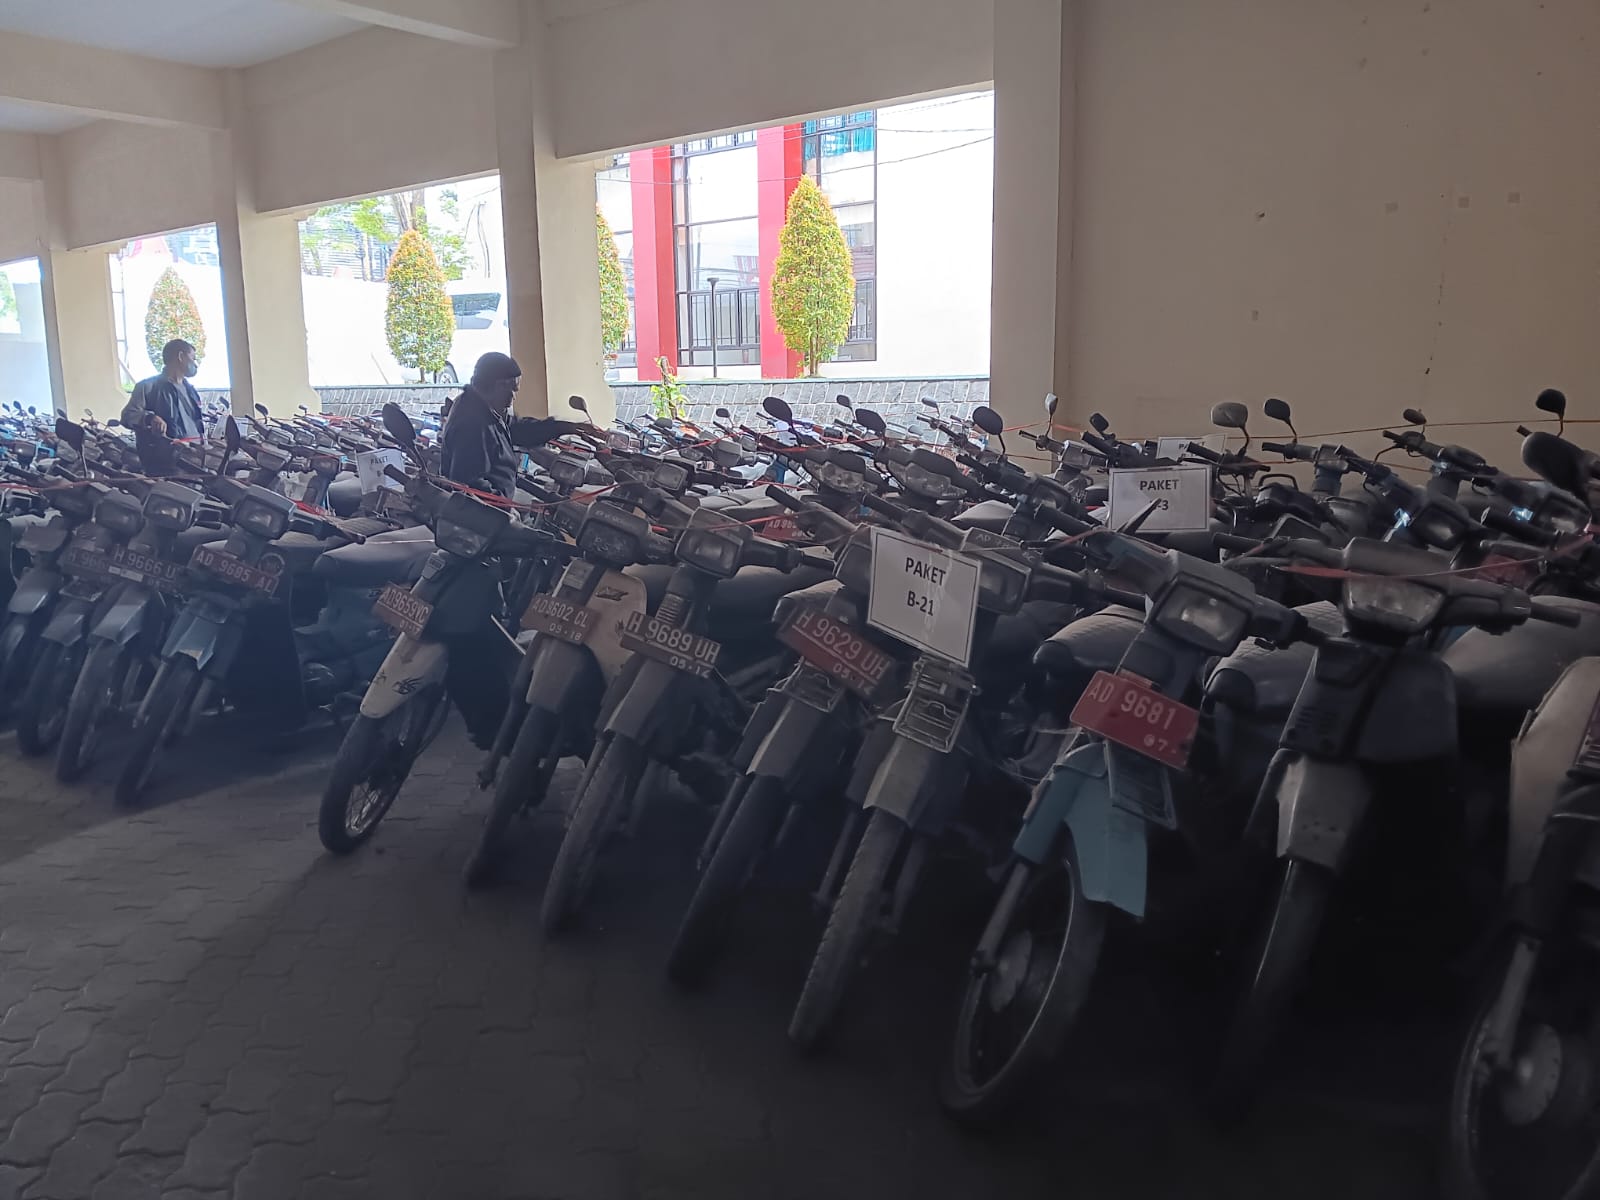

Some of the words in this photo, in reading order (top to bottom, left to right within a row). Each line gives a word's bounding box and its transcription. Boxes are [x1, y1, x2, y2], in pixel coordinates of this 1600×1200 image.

[1140, 479, 1179, 491] PAKET
[113, 544, 126, 562] H
[127, 552, 164, 576] 9666
[196, 550, 214, 566] AD
[219, 560, 253, 583] 9685
[255, 575, 273, 593] AL
[905, 556, 947, 586] PAKET
[574, 610, 588, 628] CL
[907, 590, 934, 617] B-21
[627, 611, 645, 634] H
[645, 619, 694, 653] 9689
[694, 639, 721, 665] UH
[795, 606, 816, 629] H
[812, 617, 863, 661] 9629
[860, 649, 891, 680] UH
[1087, 679, 1115, 703] AD
[1120, 689, 1177, 731] 9681
